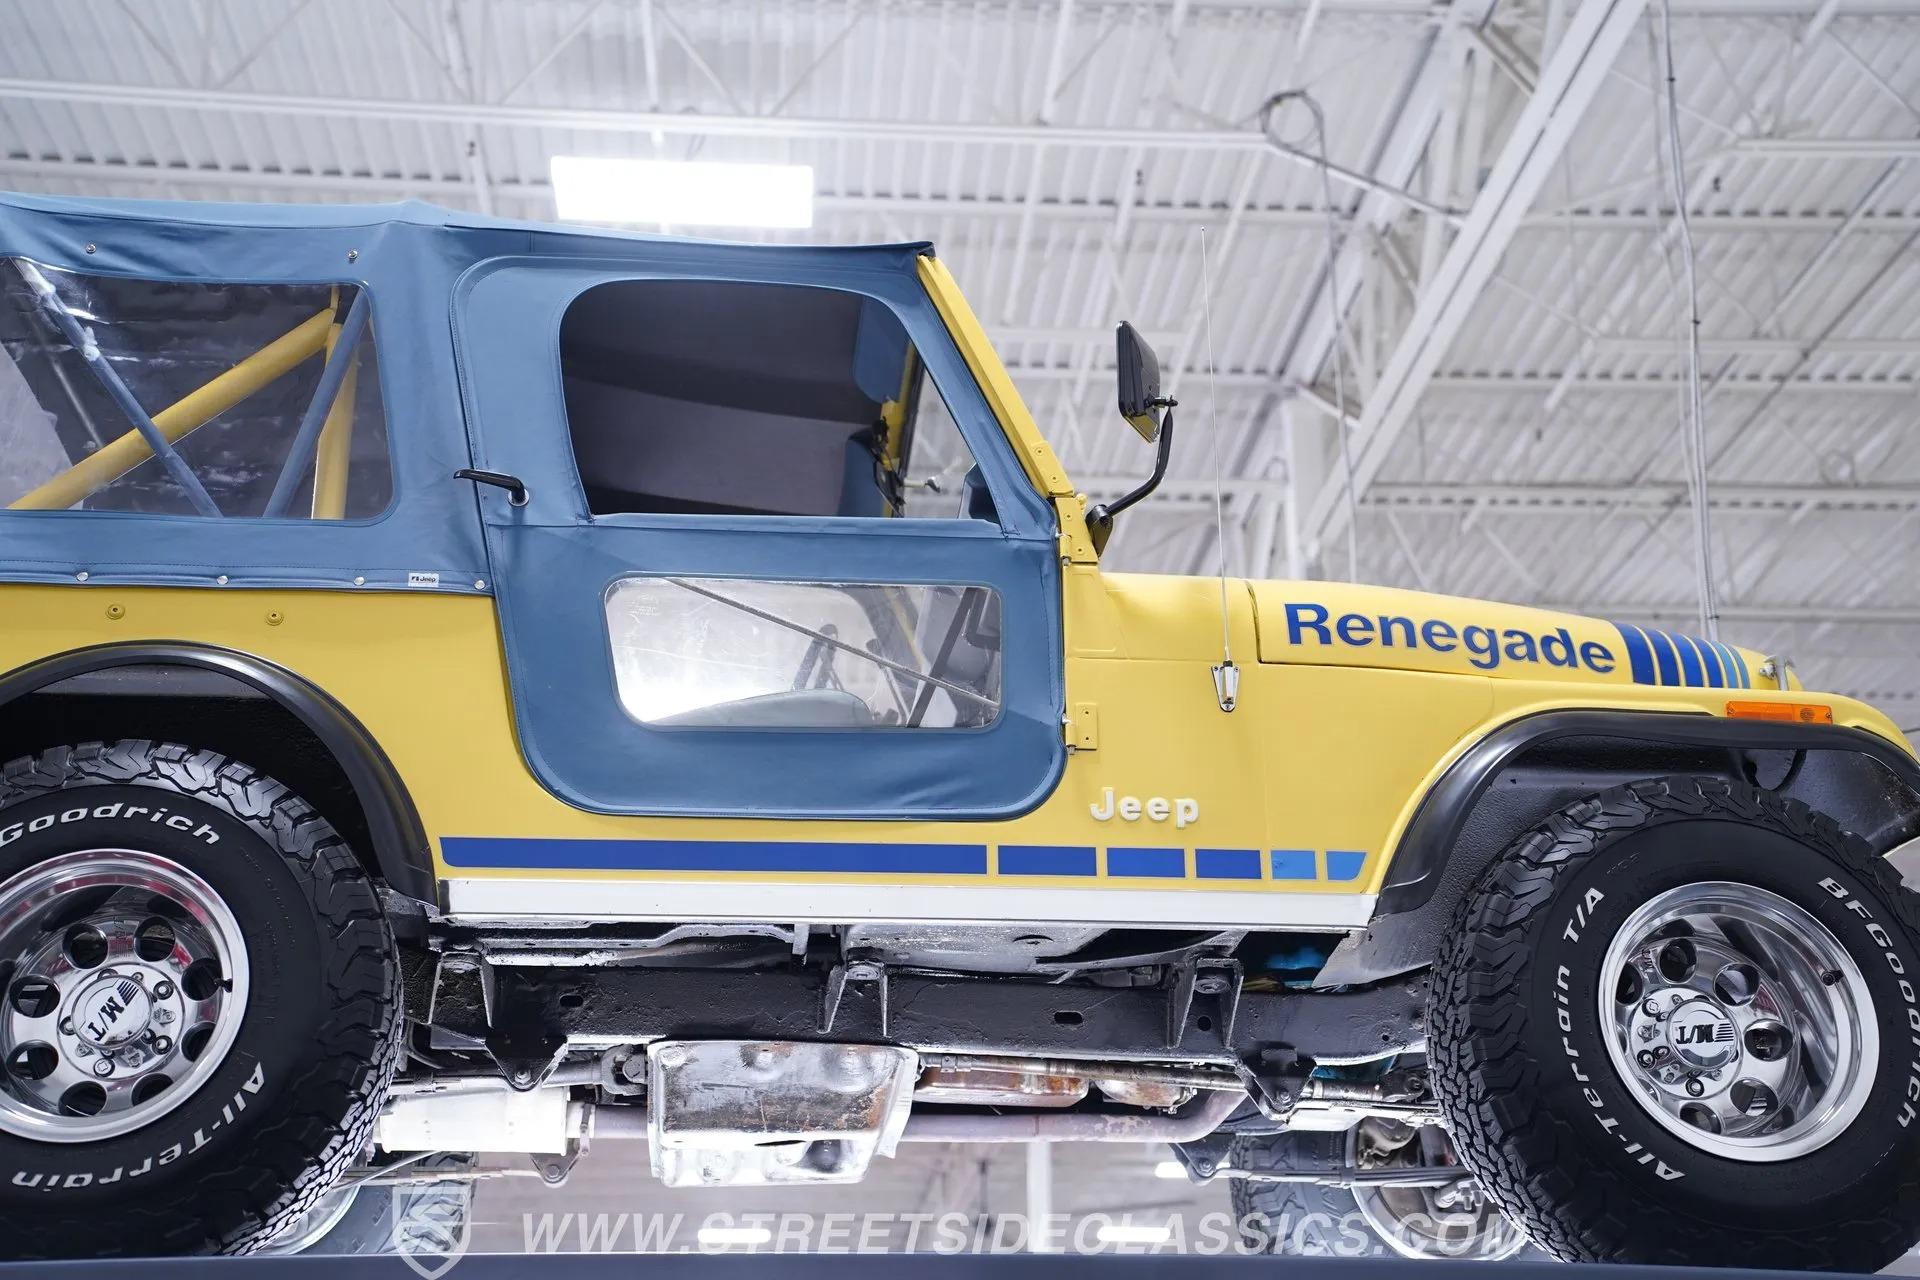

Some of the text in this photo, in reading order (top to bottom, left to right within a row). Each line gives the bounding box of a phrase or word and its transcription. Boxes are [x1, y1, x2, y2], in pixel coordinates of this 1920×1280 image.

[1283, 603, 1617, 674] Renegade
[0, 803, 221, 848] Goodrich
[1089, 787, 1200, 829] Jeep
[1563, 887, 1605, 943] T/A
[88, 996, 125, 1042] M/T
[1676, 1024, 1715, 1044] M/T
[1553, 965, 1686, 1181] All-Terrain
[12, 1061, 265, 1192] All-Terrain
